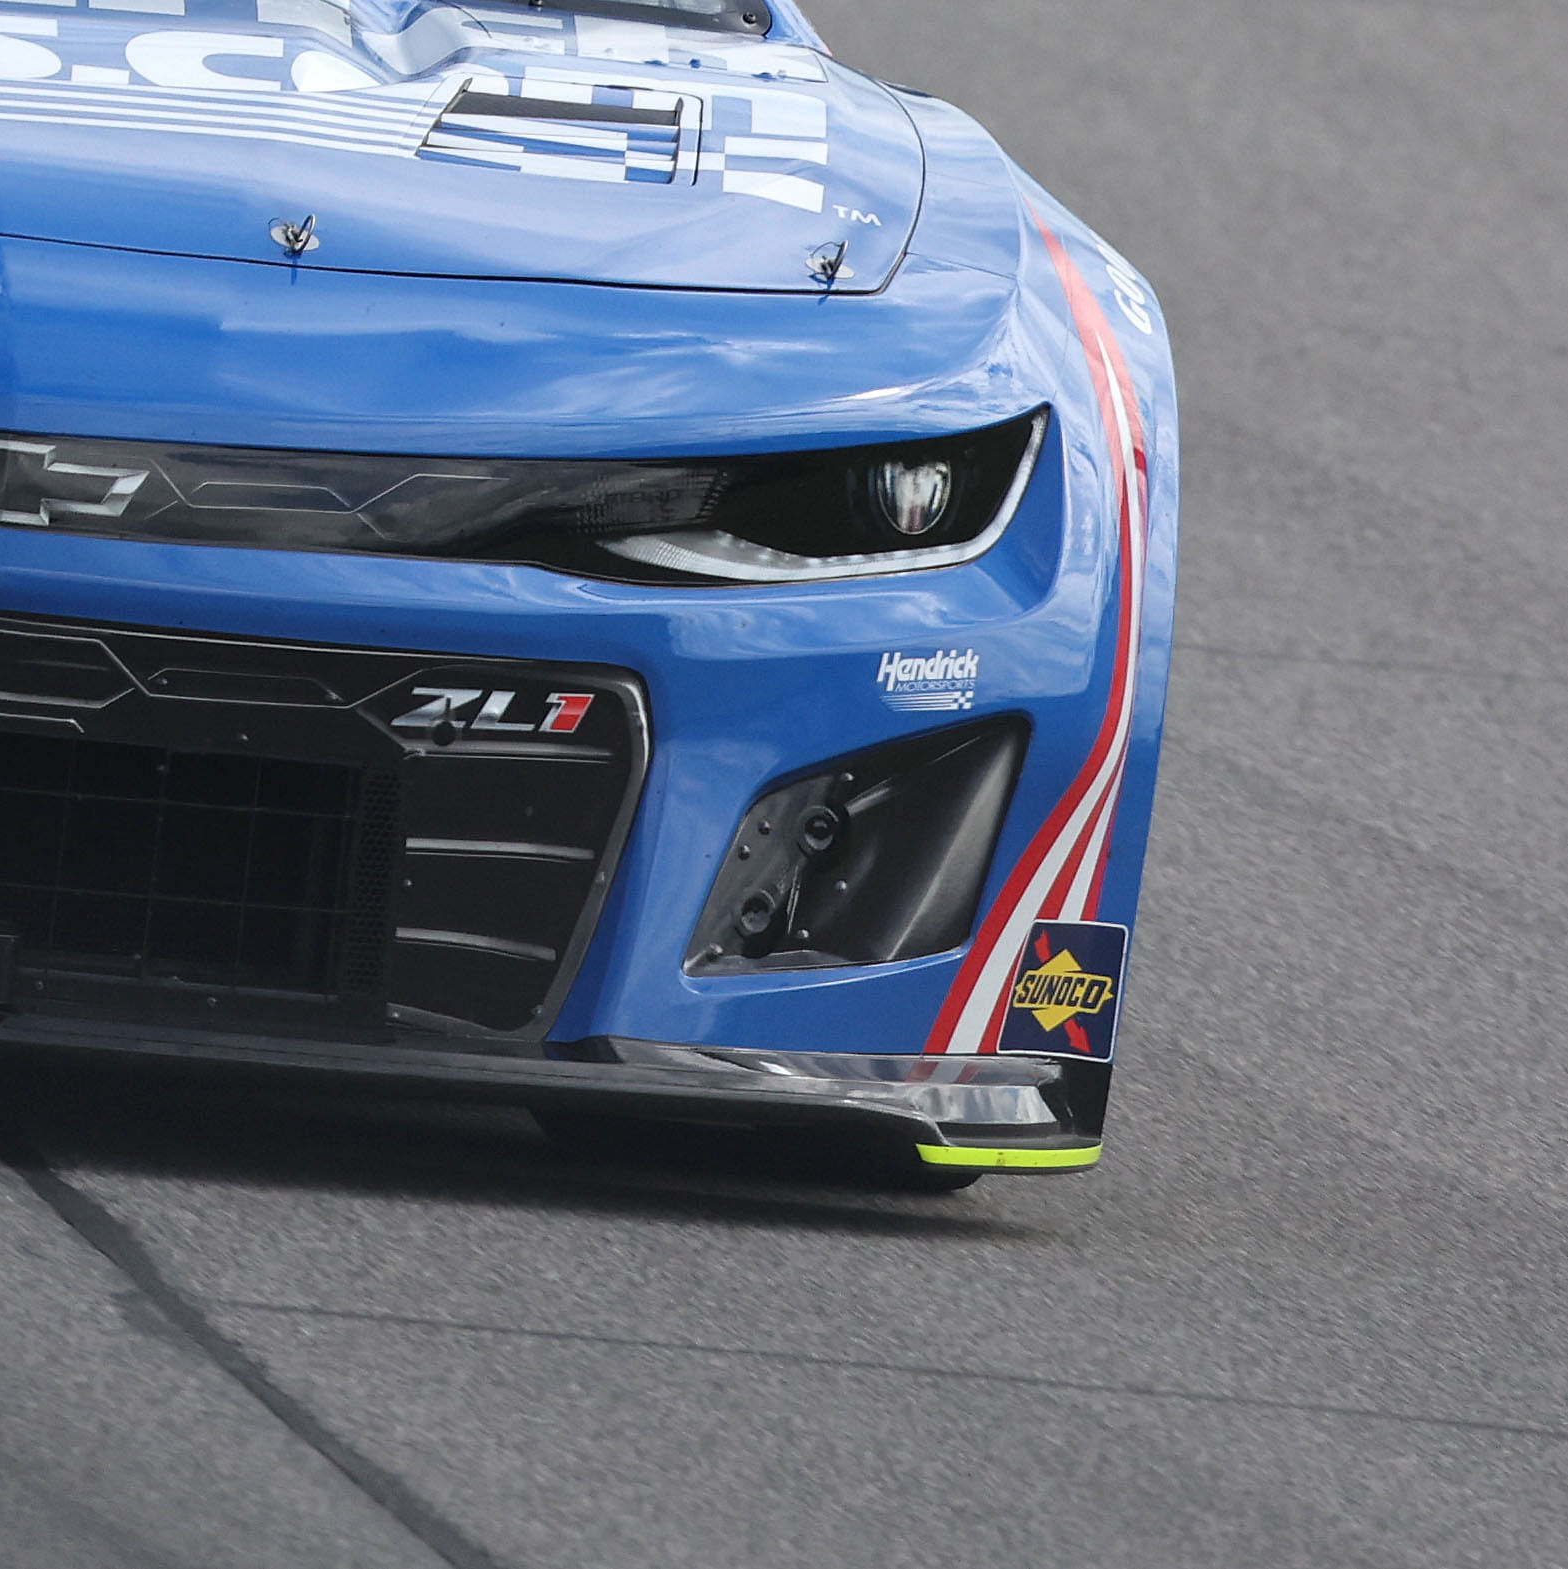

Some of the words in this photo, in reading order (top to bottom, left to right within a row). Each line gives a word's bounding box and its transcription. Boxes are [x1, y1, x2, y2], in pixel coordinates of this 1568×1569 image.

[832, 204, 882, 227] TM
[876, 648, 981, 692] Hendrick
[894, 678, 976, 693] MOTORSPORTS
[391, 686, 596, 734] ZL1
[1015, 973, 1108, 1010] SUNOCO
